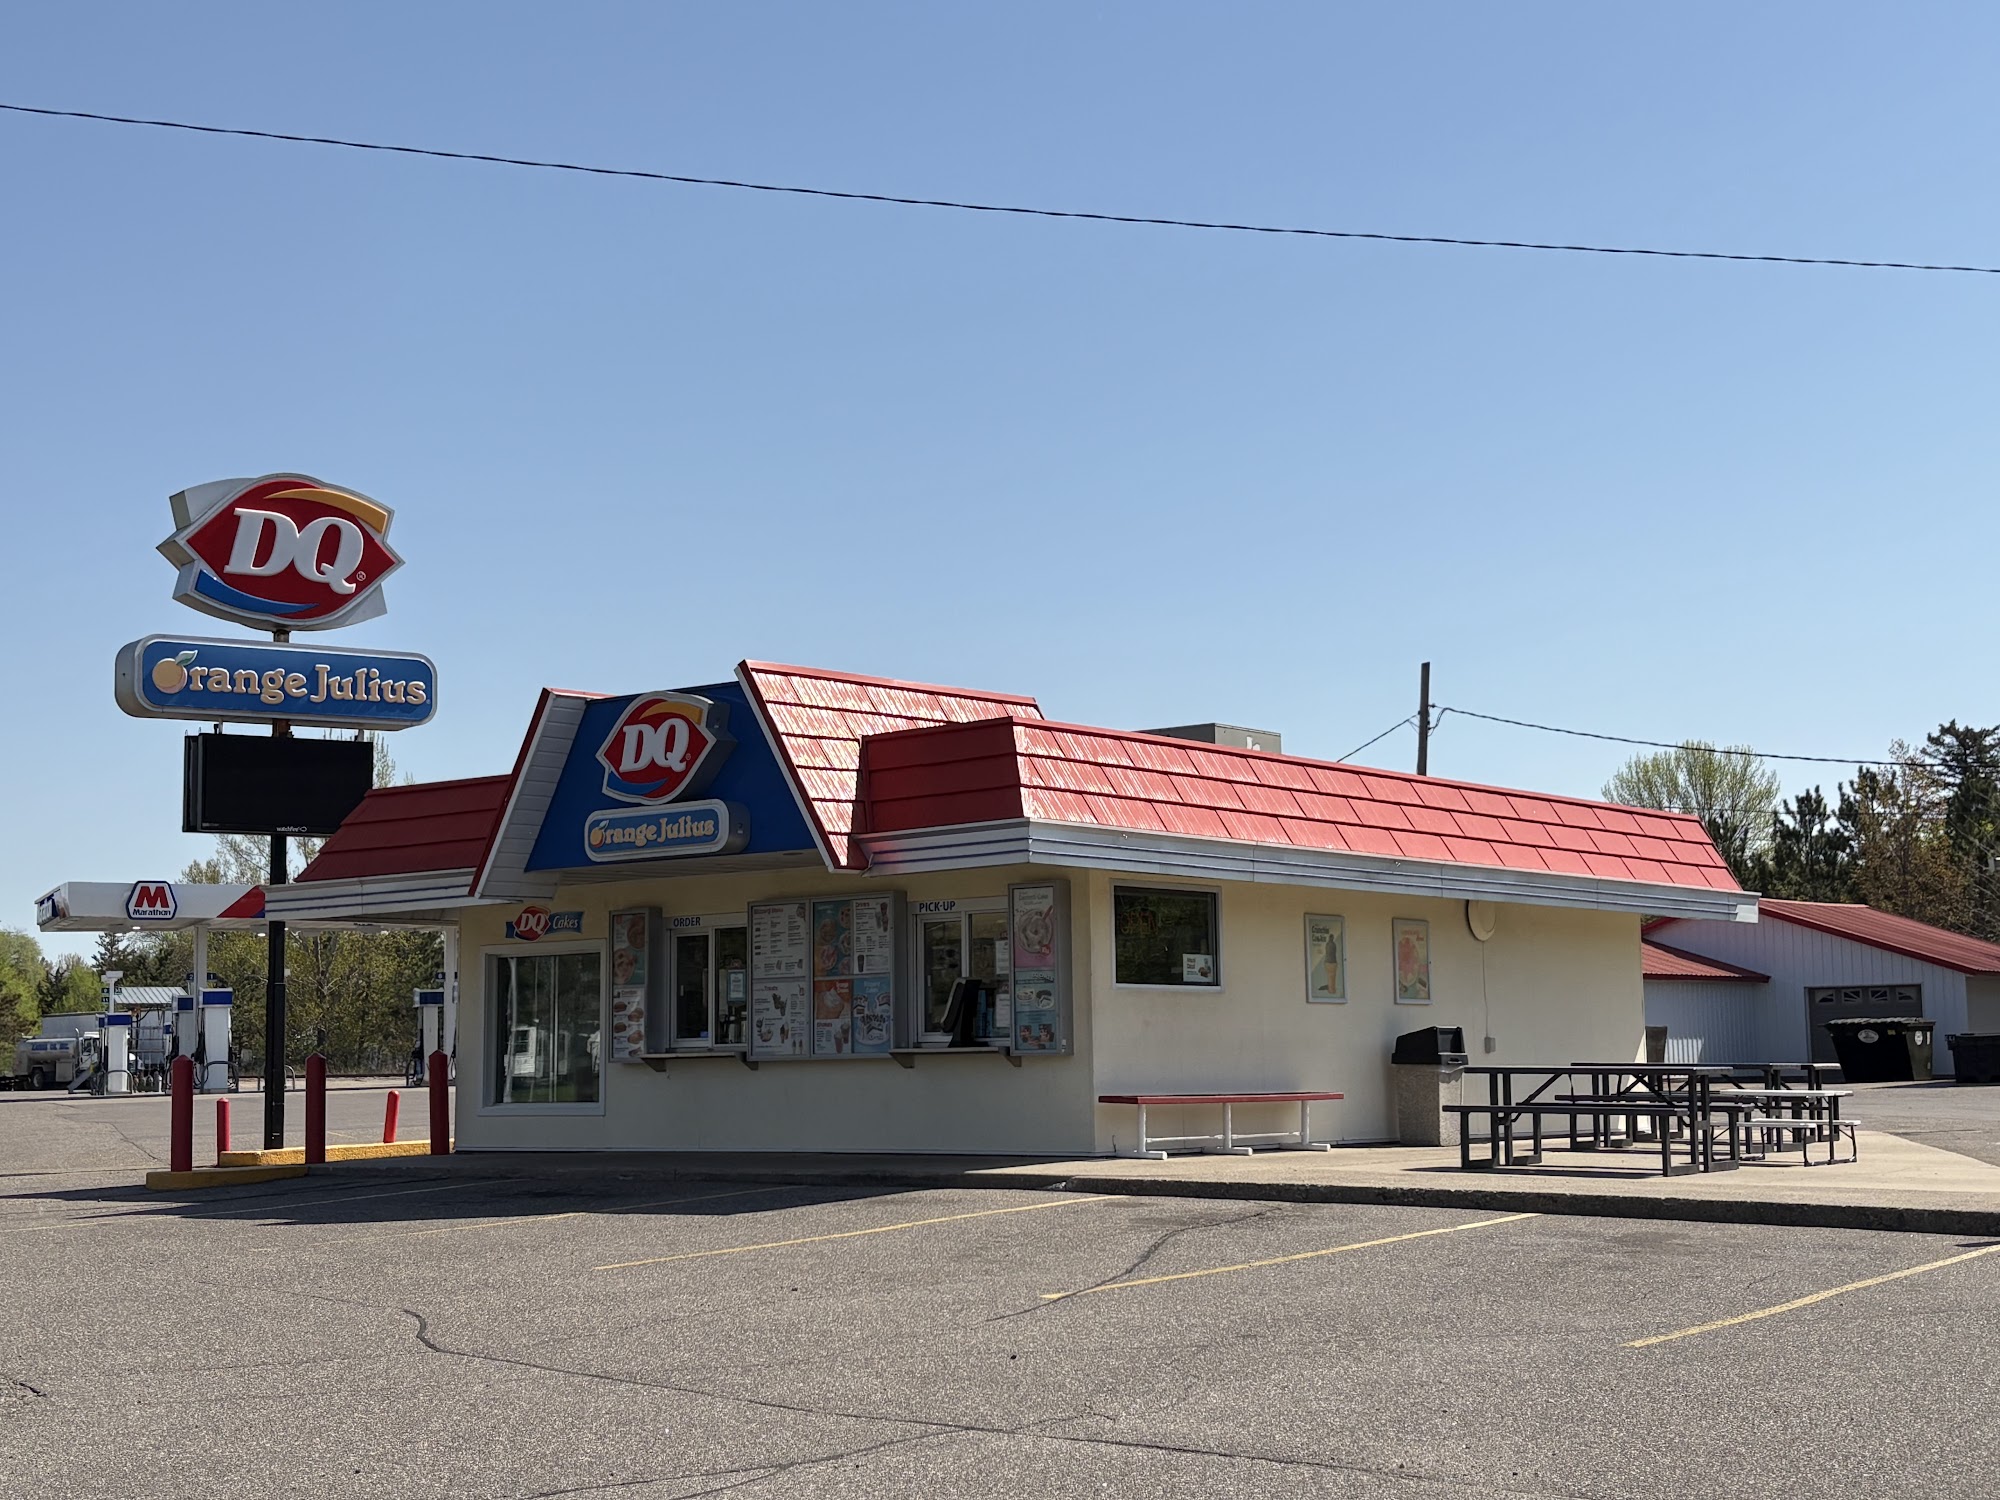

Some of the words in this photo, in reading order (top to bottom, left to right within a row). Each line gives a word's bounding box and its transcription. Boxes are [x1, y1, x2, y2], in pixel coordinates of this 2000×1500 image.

[223, 507, 364, 595] DQ
[152, 650, 307, 704] Orange
[310, 664, 426, 705] Julius
[619, 718, 689, 773] DQ
[590, 820, 657, 848] Orange
[657, 815, 715, 843] Julius
[134, 886, 169, 908] M
[919, 901, 956, 912] PICK-UP
[132, 908, 171, 916] Marathon
[673, 916, 701, 927] ORDER
[519, 913, 547, 934] DQ
[552, 914, 579, 930] Cakes
